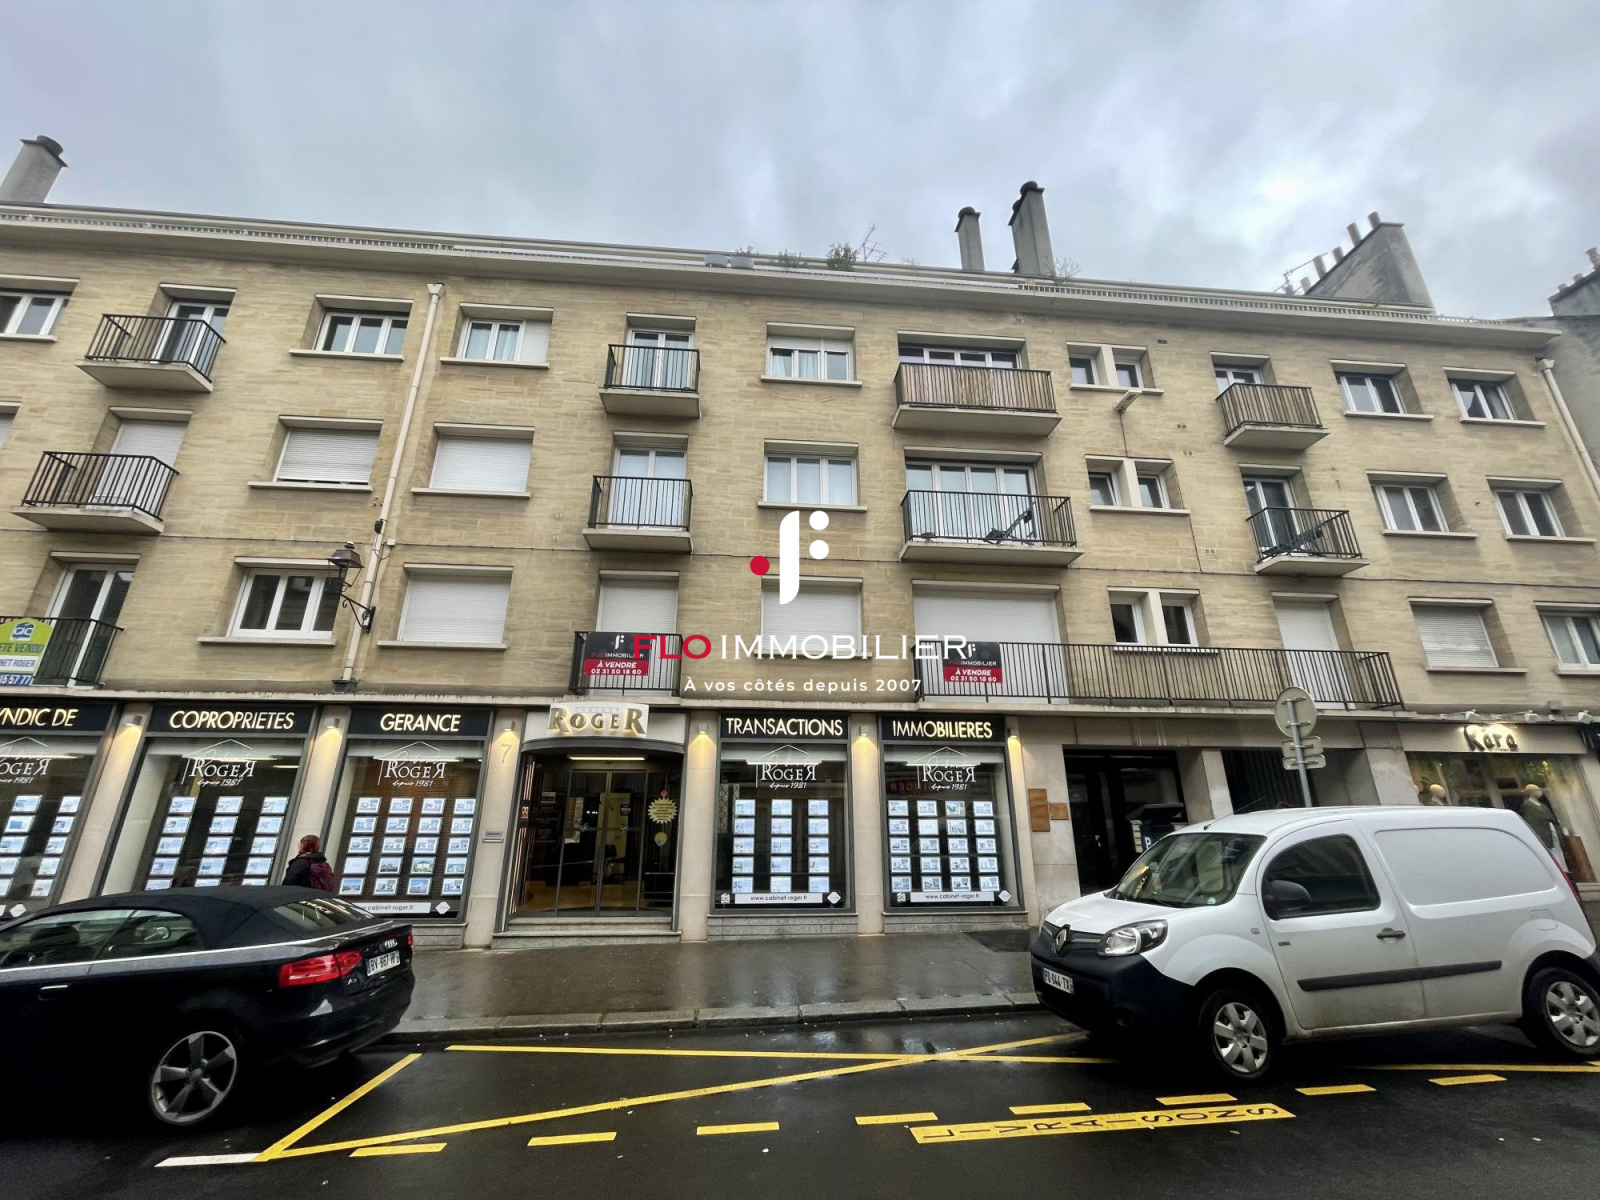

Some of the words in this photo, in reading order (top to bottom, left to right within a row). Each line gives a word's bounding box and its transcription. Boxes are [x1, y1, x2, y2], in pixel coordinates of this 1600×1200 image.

[597, 660, 603, 668] À
[605, 661, 637, 669] VENDRE
[20, 674, 32, 685] 77
[52, 708, 79, 727] DE
[169, 710, 295, 730] COPROPRIETES
[380, 713, 462, 732] GERANCE
[548, 707, 646, 735] ROGER
[725, 717, 843, 736] TRANSACTIONS
[892, 720, 993, 738] IMMOBILIERES
[501, 743, 512, 763] 7
[189, 758, 258, 778] ROGER
[384, 760, 447, 779] ROGER
[760, 763, 817, 781] ROGER
[921, 764, 976, 783] ROGER
[922, 1106, 1279, 1139] LIVRAISONS
